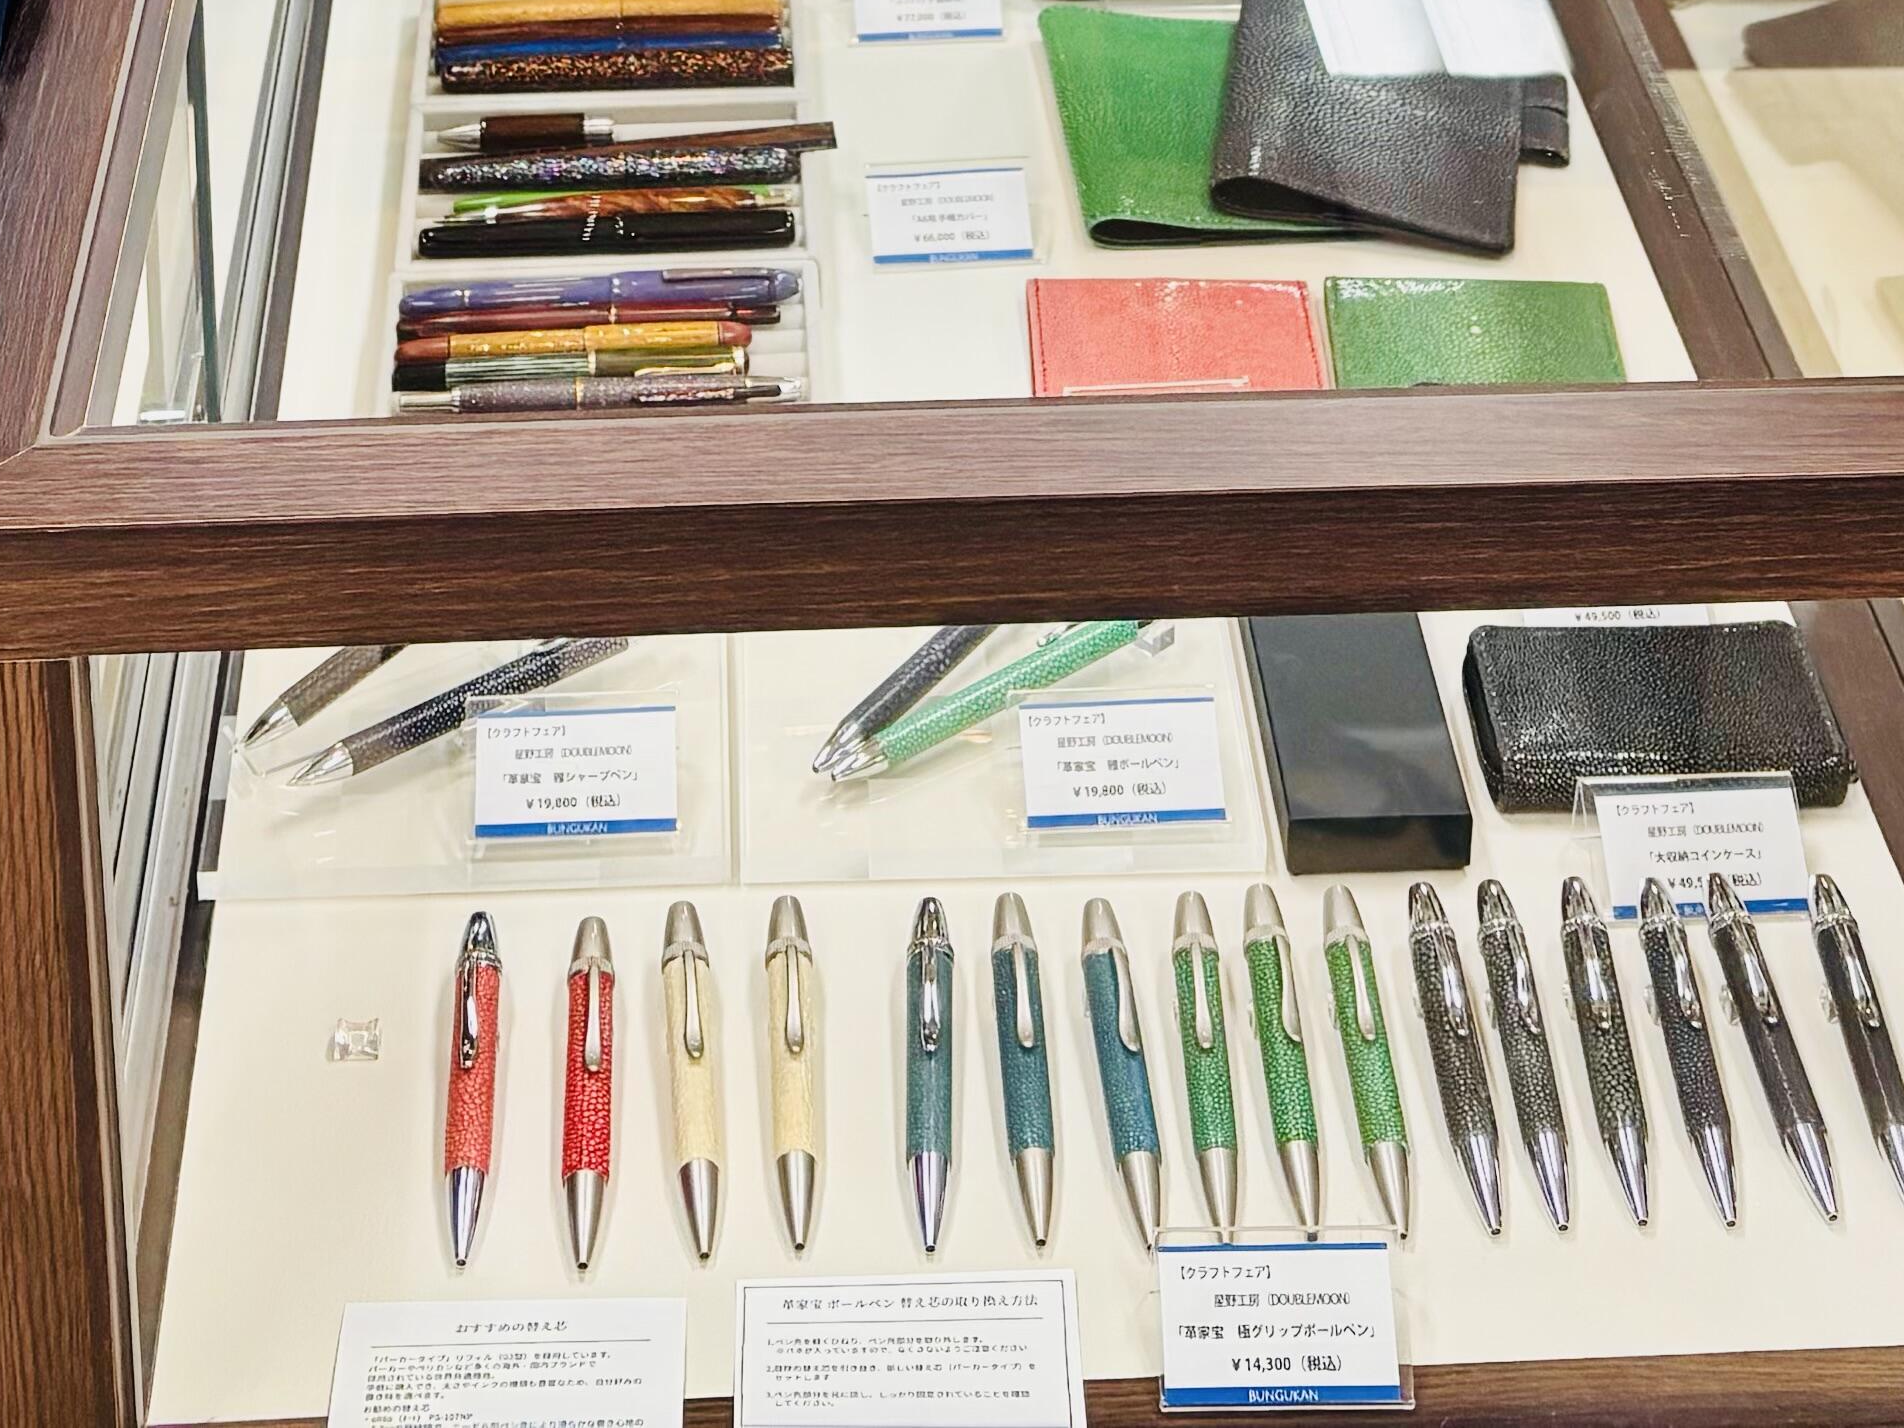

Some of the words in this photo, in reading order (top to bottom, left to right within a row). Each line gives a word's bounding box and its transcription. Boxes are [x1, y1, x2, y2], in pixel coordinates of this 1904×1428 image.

[1180, 1264, 1272, 1280] 【クラフトフェア】
[1248, 1389, 1319, 1403] BUNGUKAN
